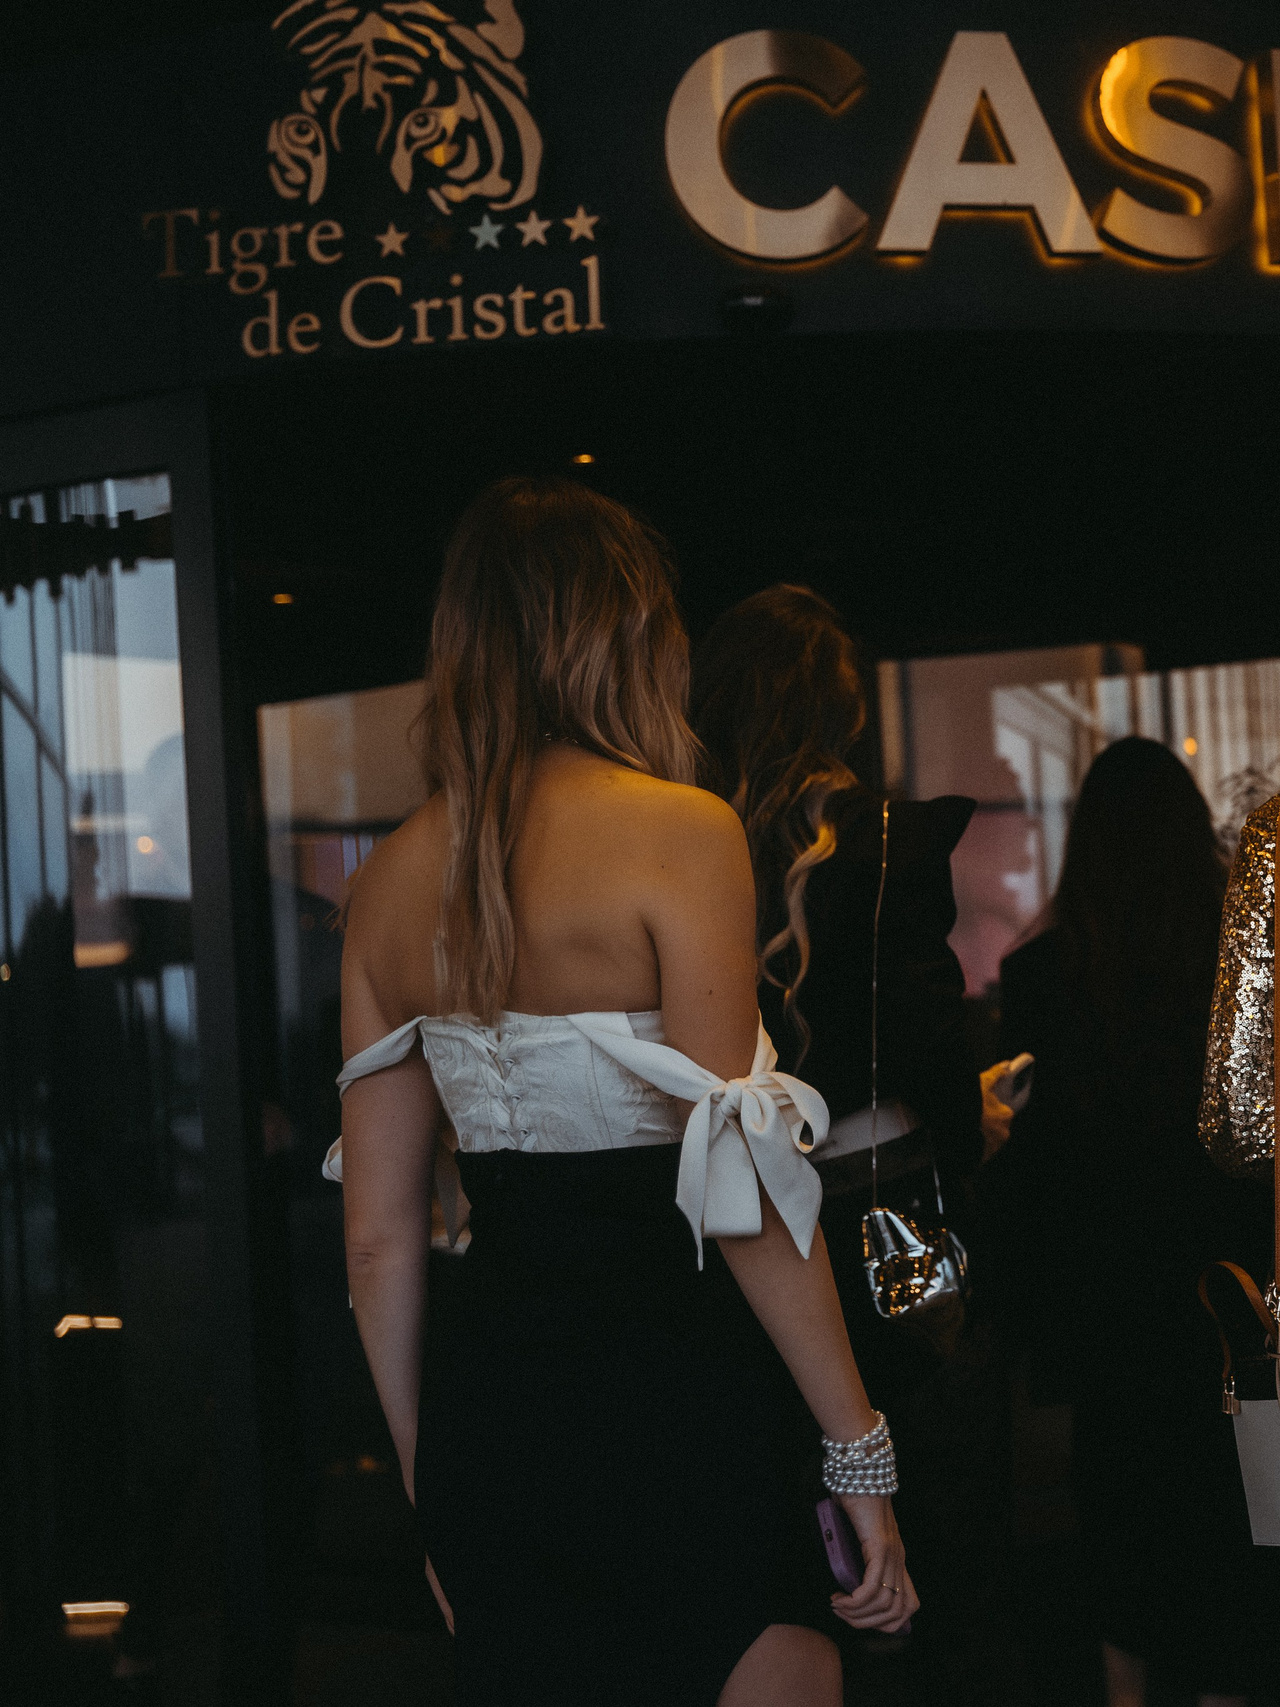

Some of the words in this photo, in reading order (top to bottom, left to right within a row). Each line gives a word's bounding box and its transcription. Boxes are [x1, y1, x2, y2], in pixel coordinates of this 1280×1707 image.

[142, 207, 344, 296] Tigre
[241, 289, 322, 358] de
[339, 255, 606, 349] Cristal
